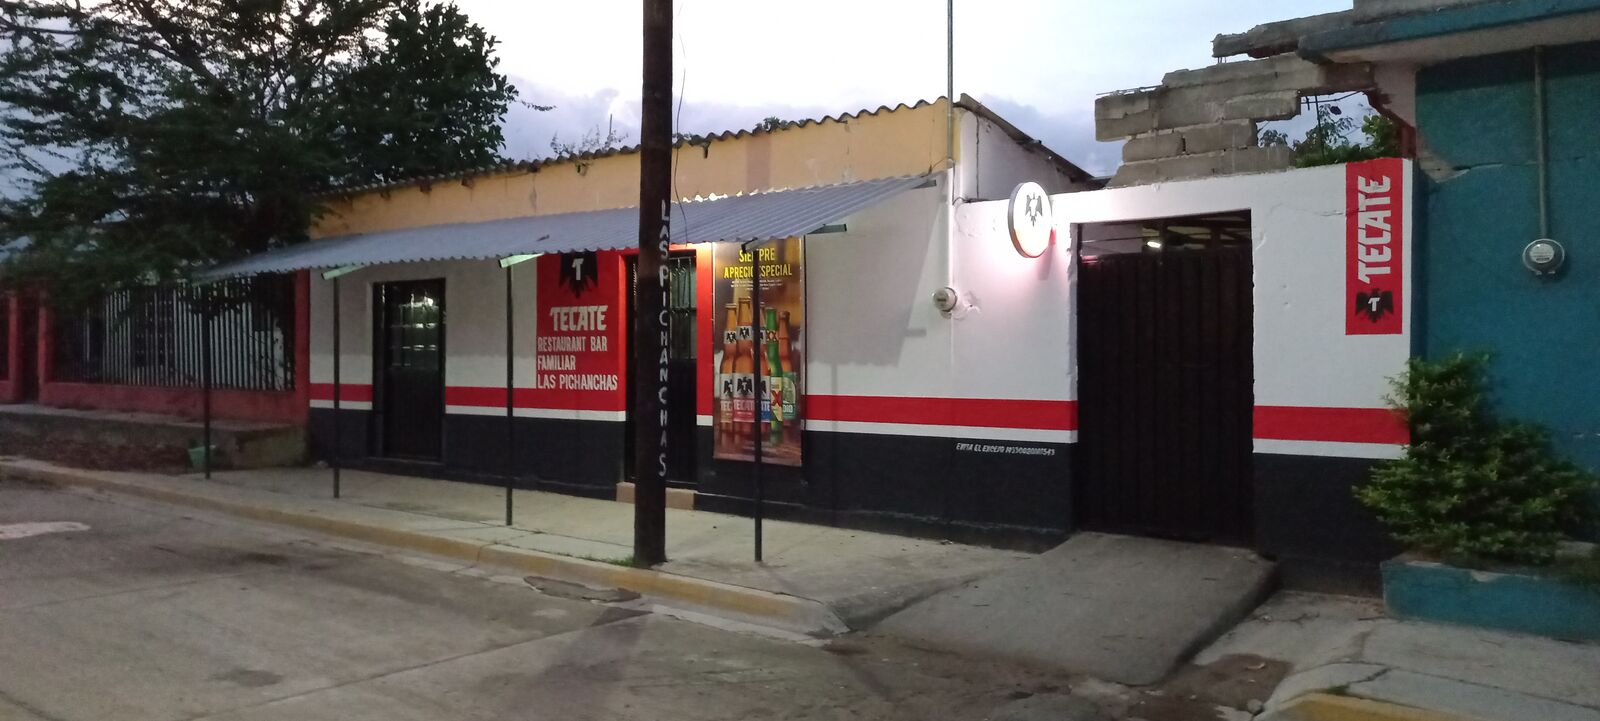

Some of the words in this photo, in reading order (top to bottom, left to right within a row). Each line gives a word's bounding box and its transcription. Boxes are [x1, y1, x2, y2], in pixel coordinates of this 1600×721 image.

[658, 199, 670, 259] LAS
[1357, 175, 1392, 284] TECATE
[739, 248, 775, 262] SIEPRE
[549, 304, 608, 331] TECATE
[537, 336, 587, 352] RESTAURANT
[590, 336, 608, 352] BAR
[537, 355, 576, 371] FAMILIAR
[658, 264, 669, 478] PICHANCHAS
[537, 374, 556, 389] LAS
[559, 374, 618, 391] PICHANCHAS
[974, 443, 981, 452] EL
